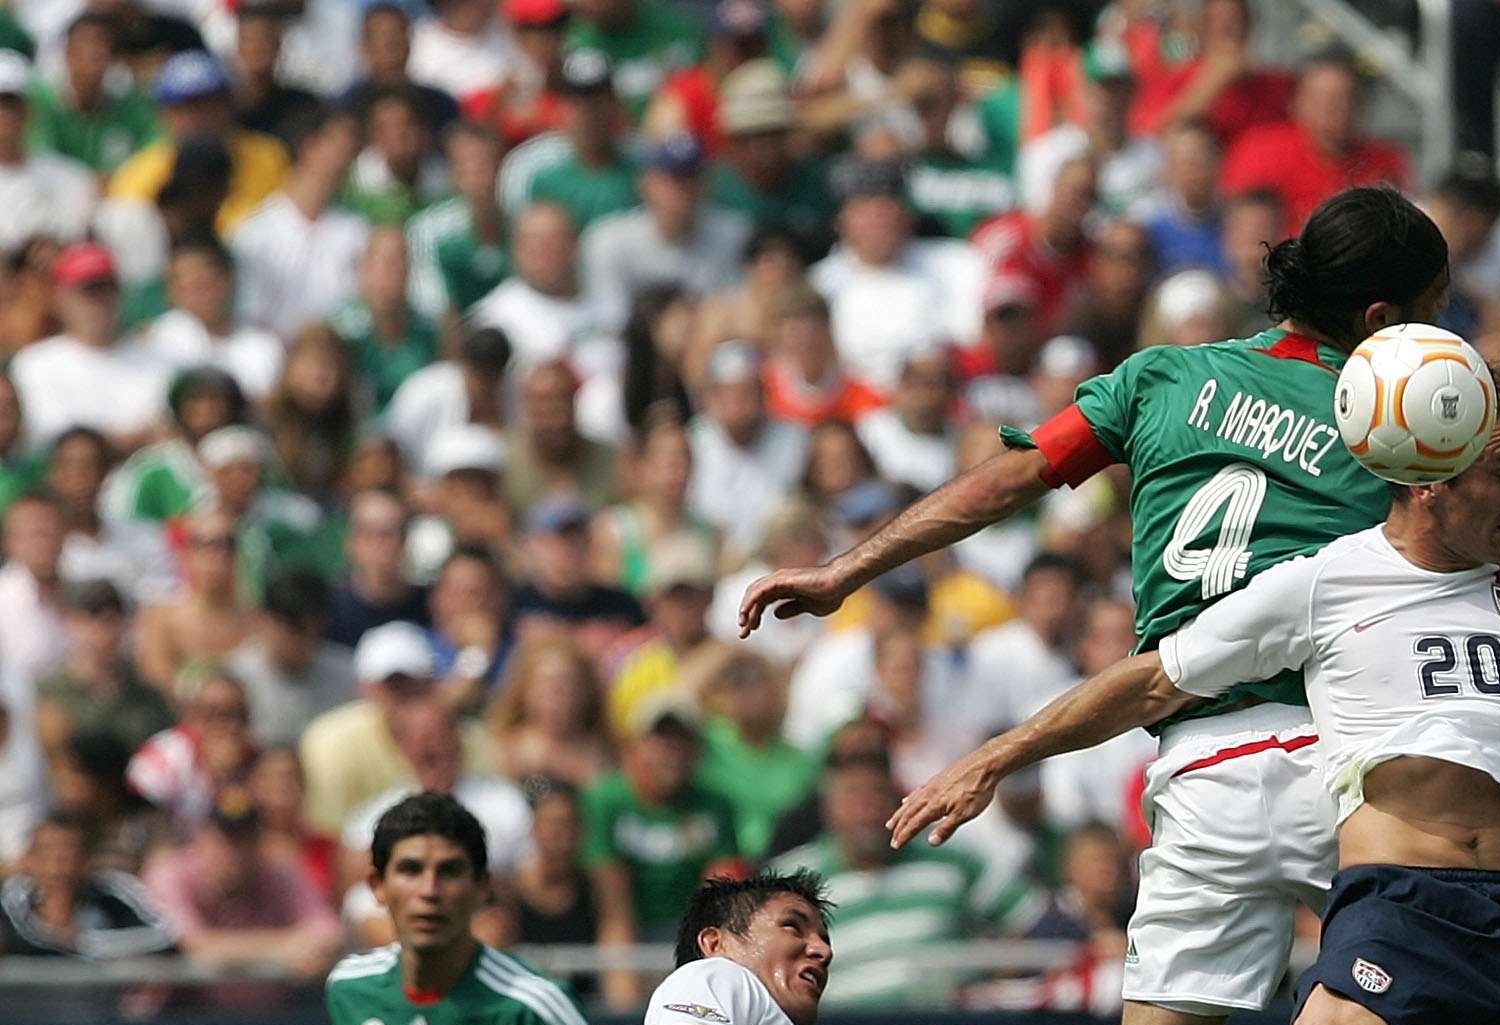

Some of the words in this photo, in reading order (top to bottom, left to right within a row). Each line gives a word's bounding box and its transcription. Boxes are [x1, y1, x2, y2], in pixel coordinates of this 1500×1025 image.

[1187, 378, 1217, 431] R.
[1216, 391, 1339, 477] MARQUEZ
[1163, 462, 1267, 600] 4
